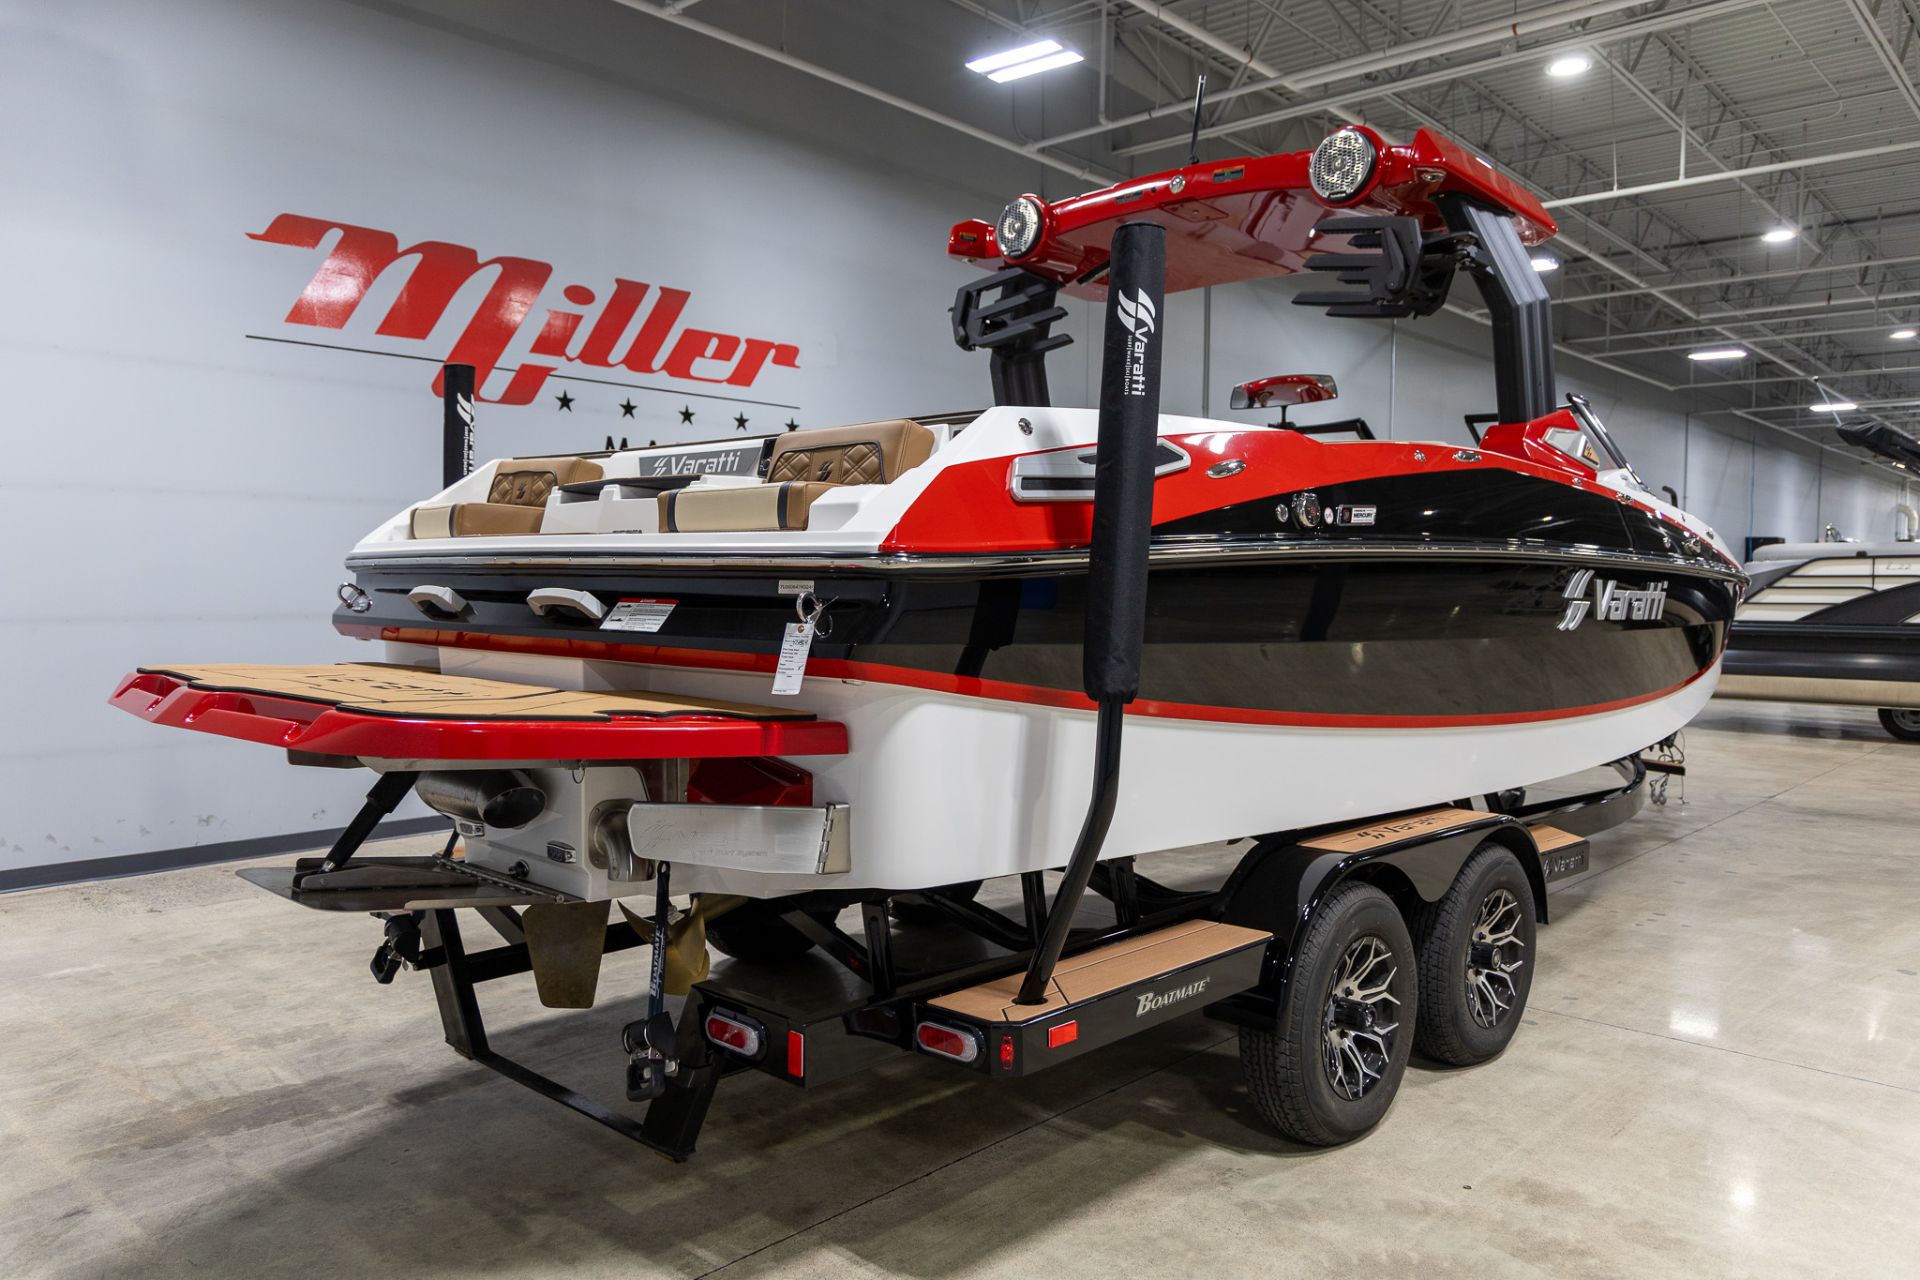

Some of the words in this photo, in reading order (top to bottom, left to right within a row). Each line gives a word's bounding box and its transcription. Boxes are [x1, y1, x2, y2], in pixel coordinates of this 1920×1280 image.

[245, 213, 801, 406] Miller
[1131, 326, 1148, 396] Varatti
[671, 451, 741, 475] Varatti
[1594, 579, 1669, 621] Varatti
